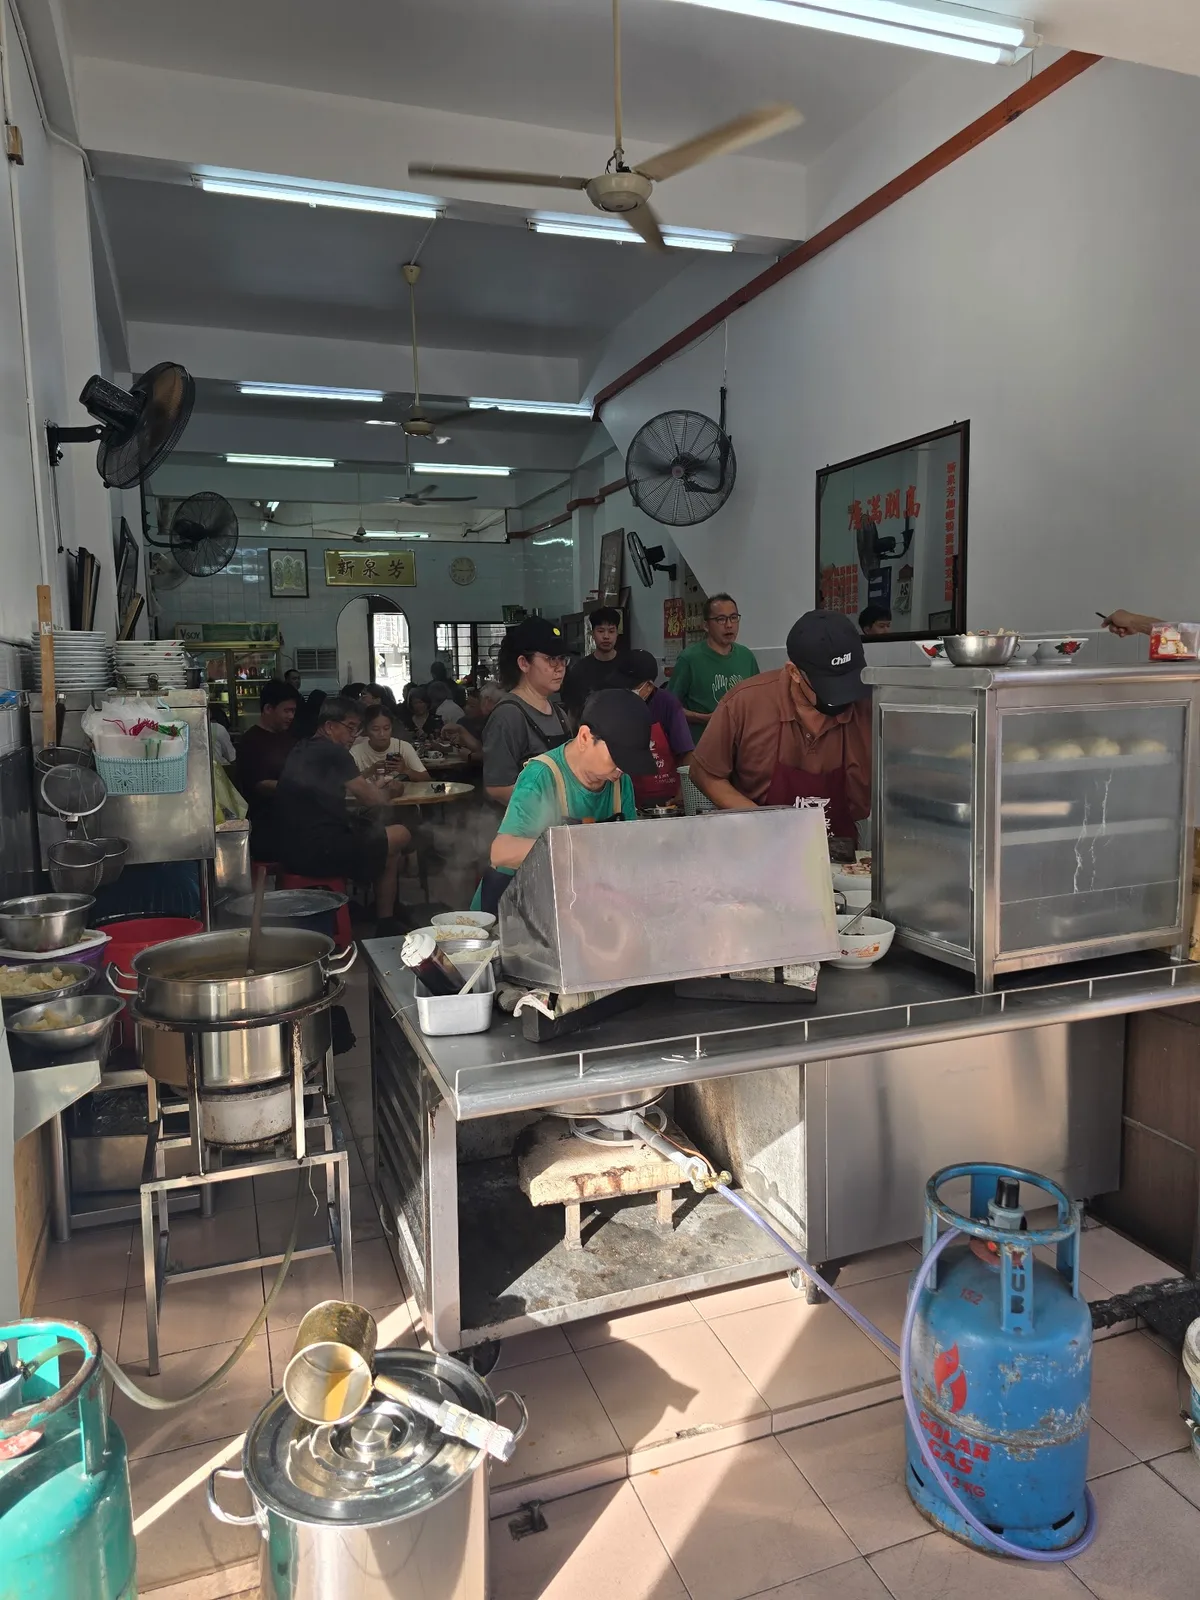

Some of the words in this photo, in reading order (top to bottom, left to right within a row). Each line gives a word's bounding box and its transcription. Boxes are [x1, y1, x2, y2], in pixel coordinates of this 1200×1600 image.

[337, 558, 405, 579] 新泉芳
[831, 652, 851, 666] Chill
[919, 1410, 991, 1462] SOLAR
[928, 1439, 974, 1475] GAS
